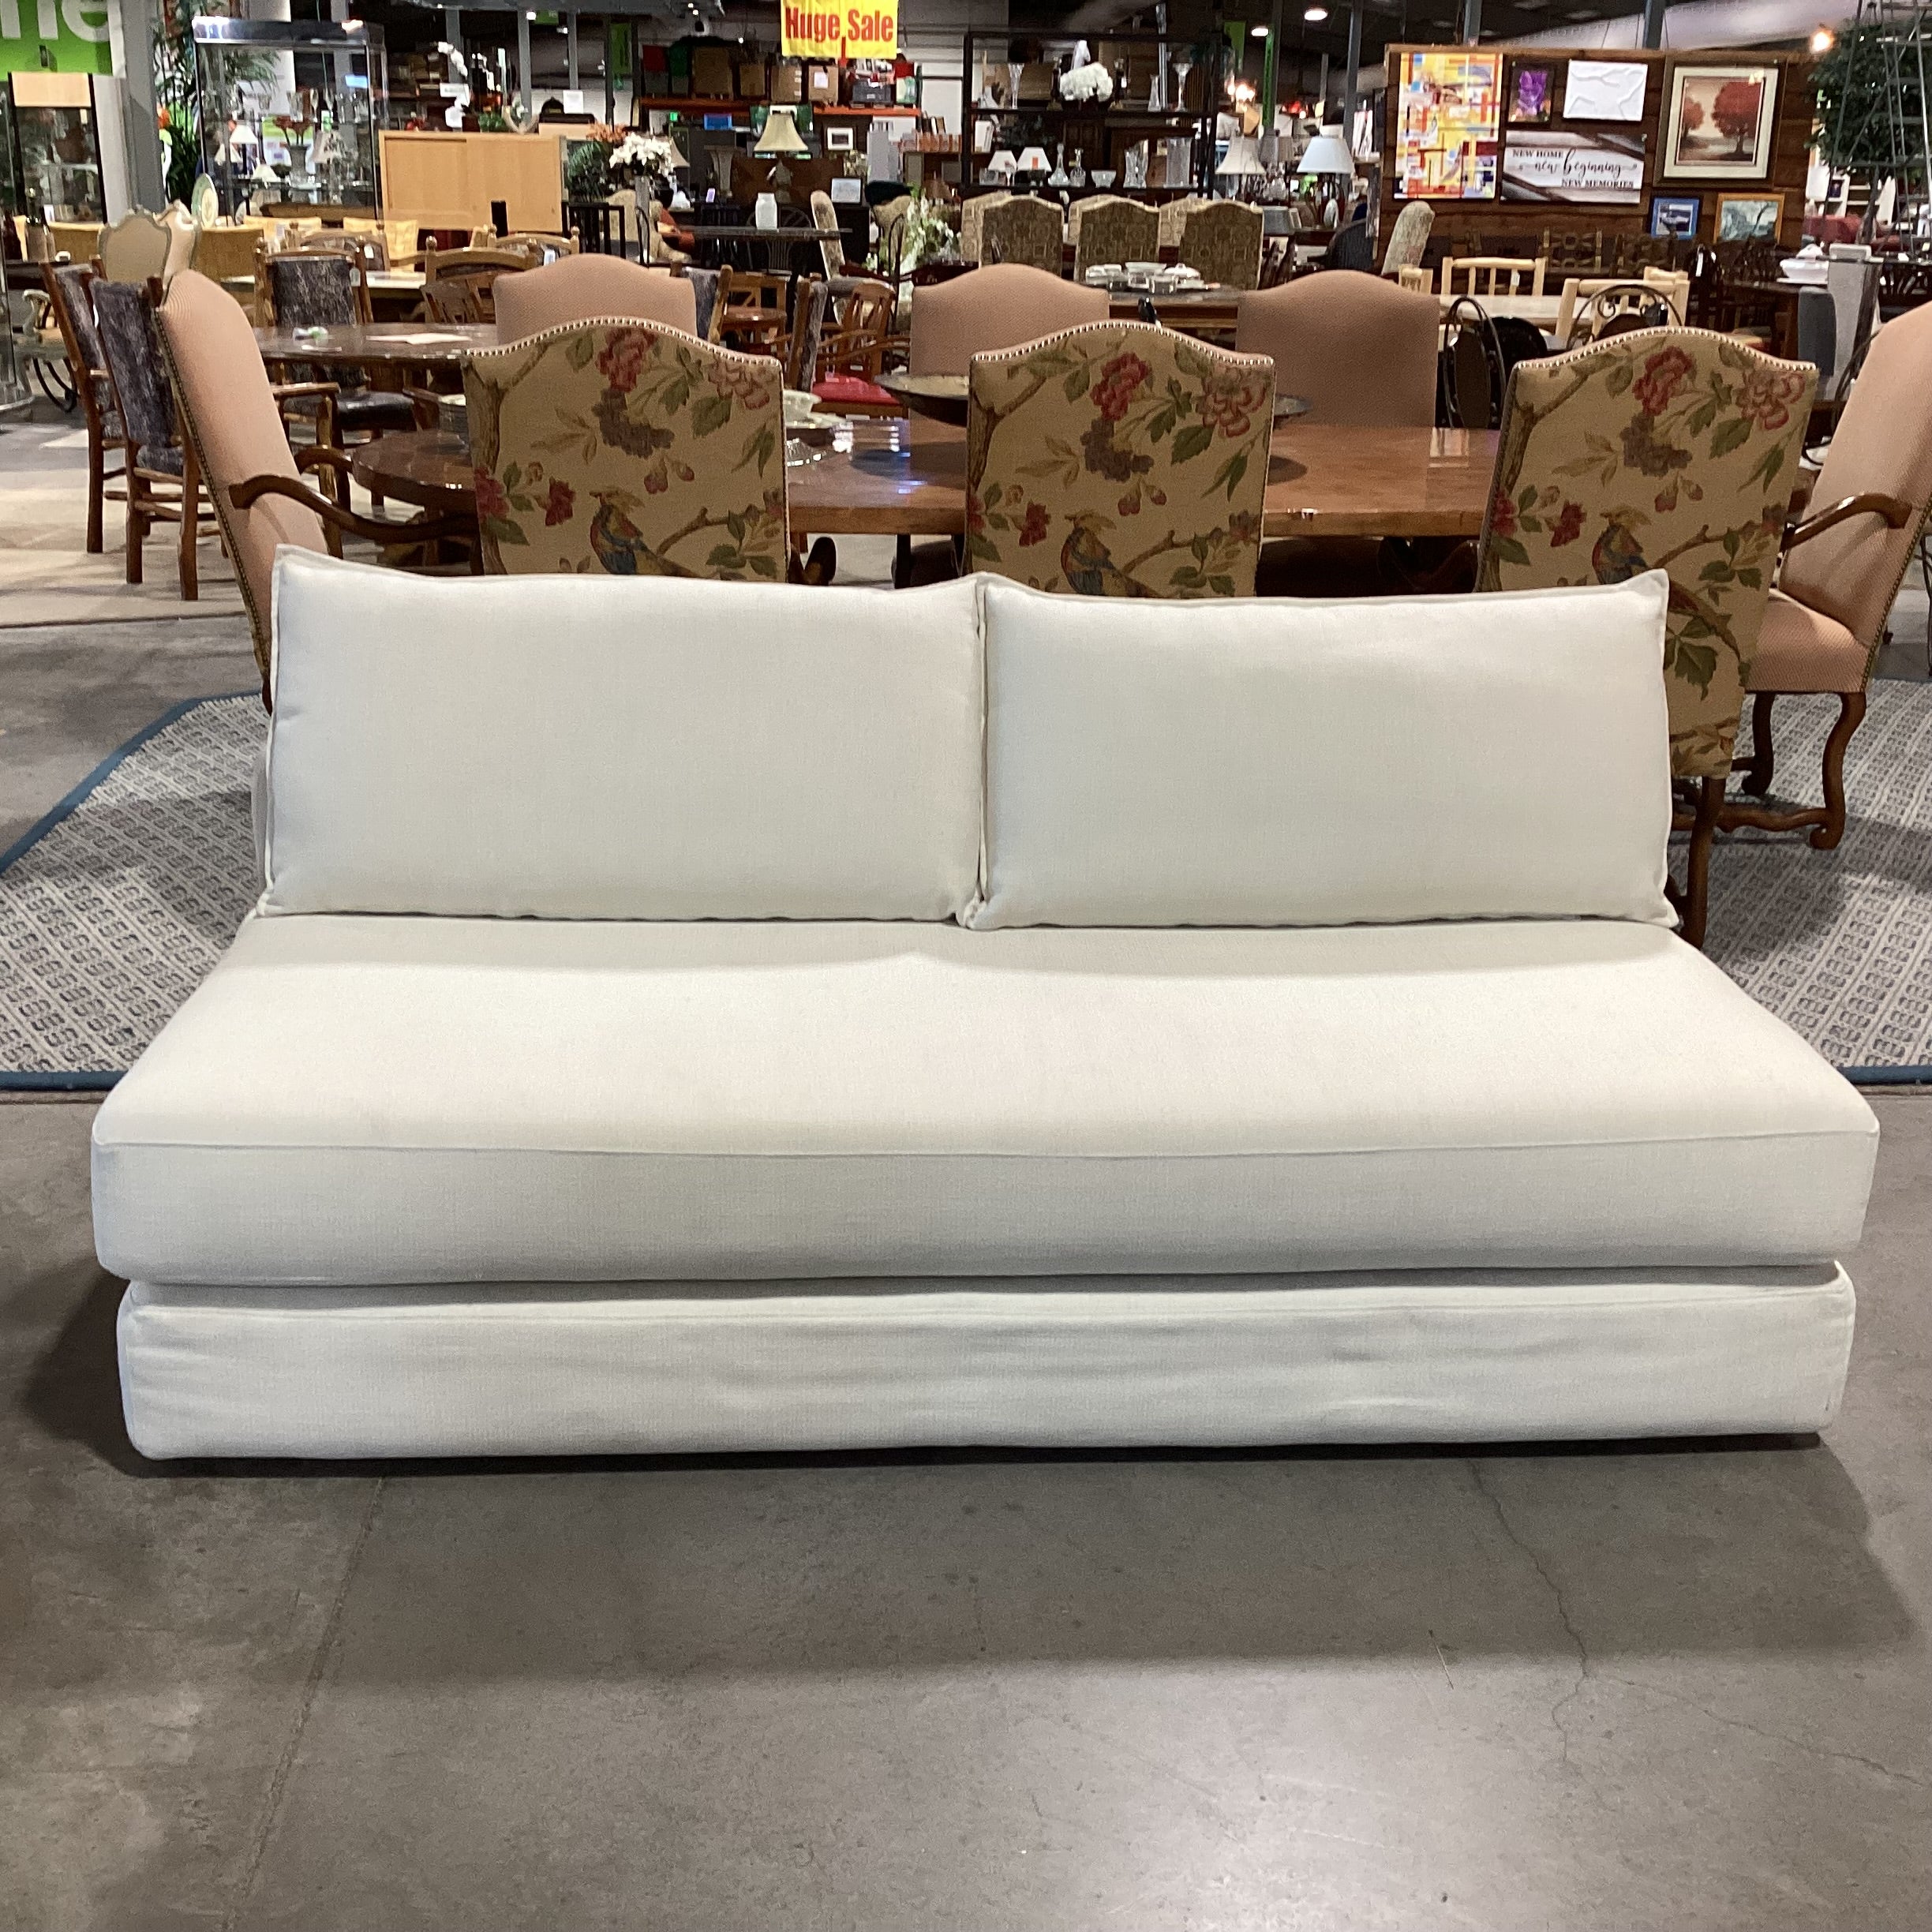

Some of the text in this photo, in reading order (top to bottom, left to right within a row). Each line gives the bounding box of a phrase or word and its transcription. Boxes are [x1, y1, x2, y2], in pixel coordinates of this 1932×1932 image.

[785, 7, 893, 43] Huge Sale
[1512, 149, 1563, 159] NEW HOME
[1563, 148, 1621, 178] beginning
[1561, 179, 1634, 189] NEW MEMORIES
